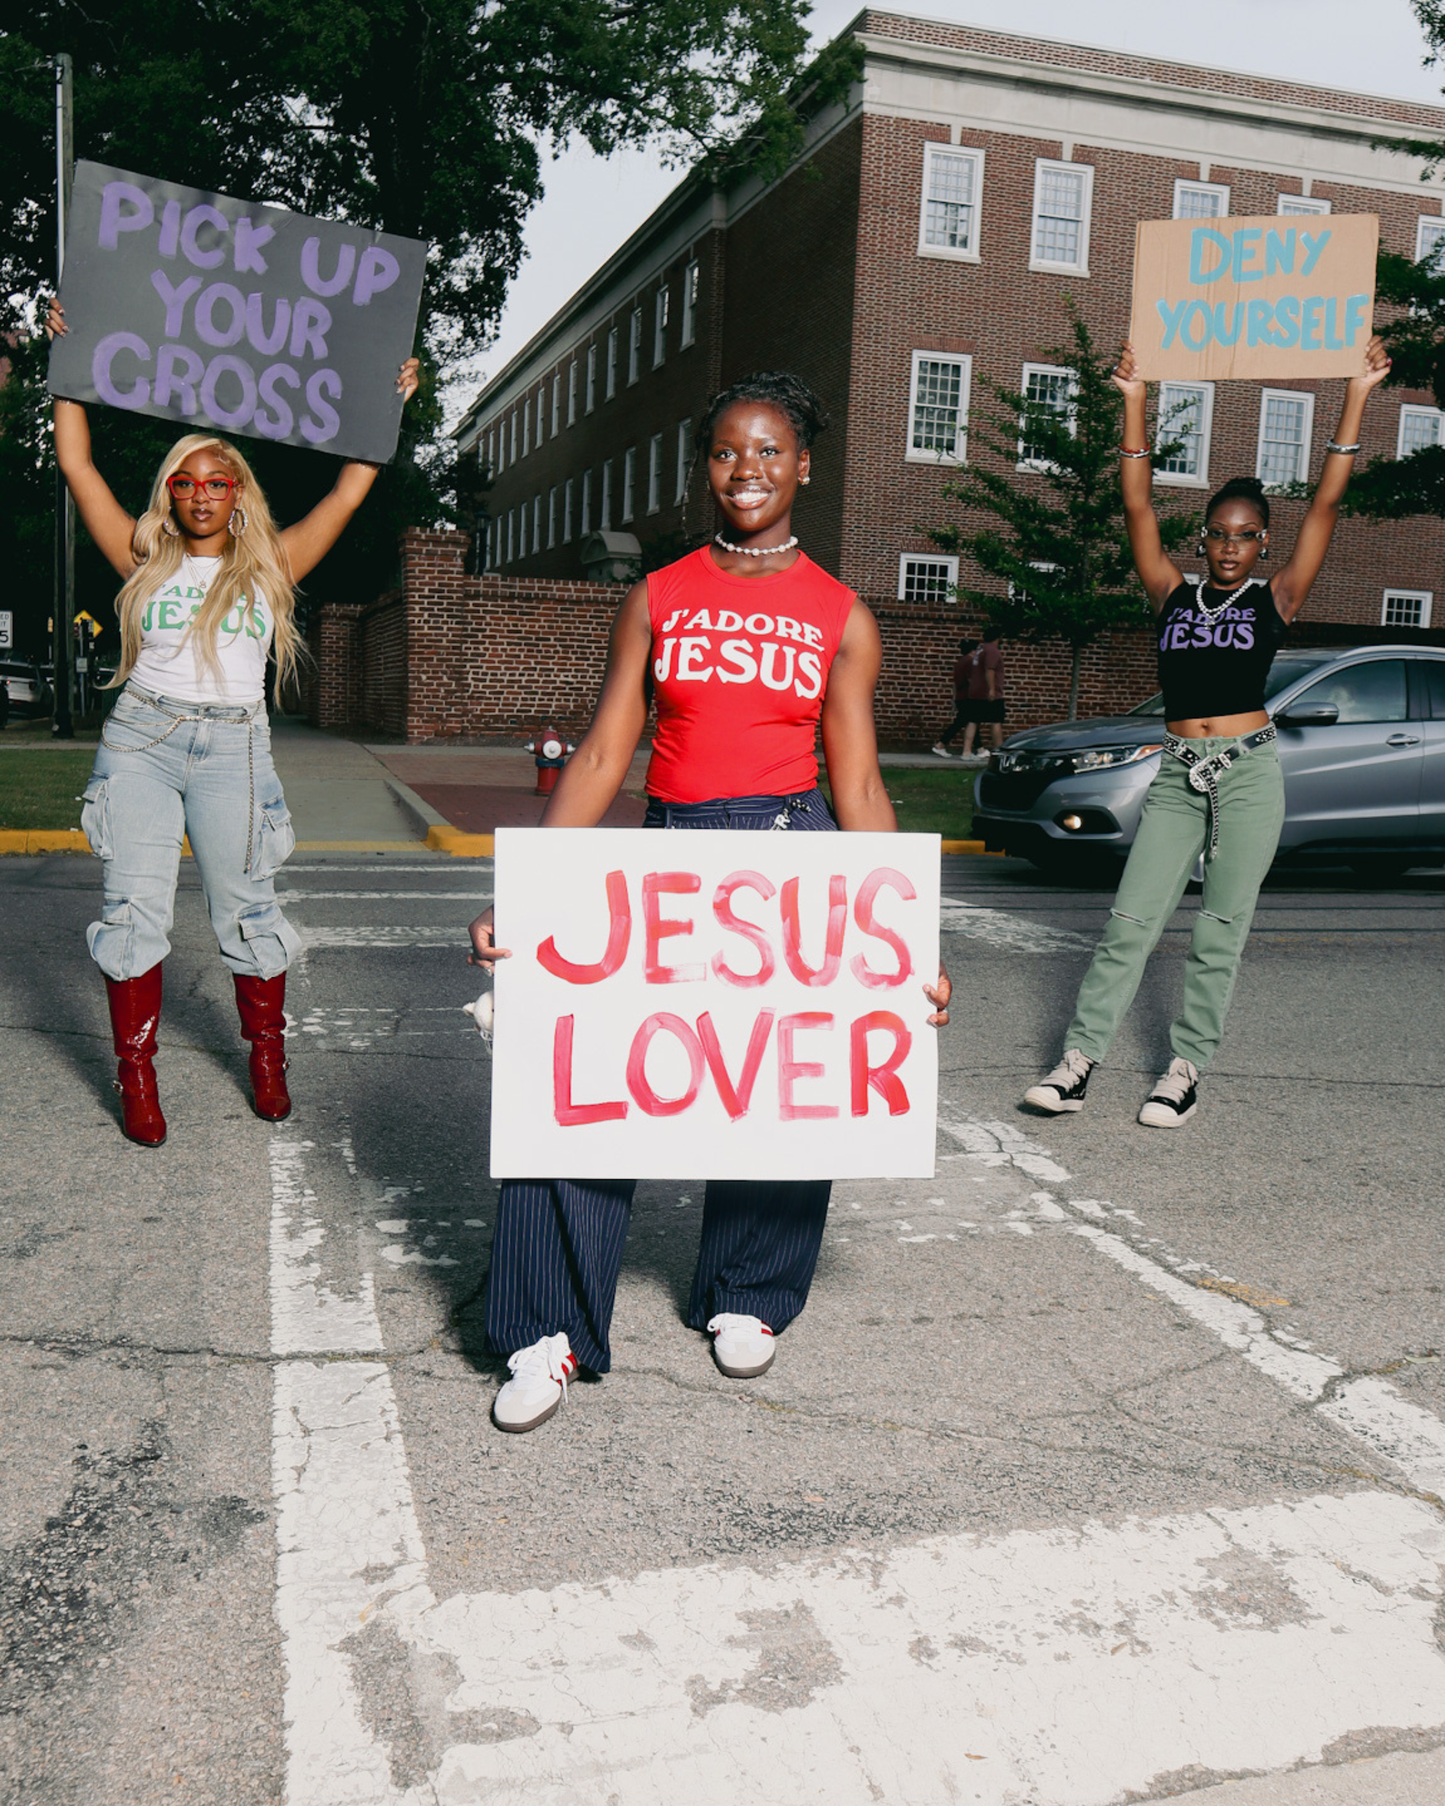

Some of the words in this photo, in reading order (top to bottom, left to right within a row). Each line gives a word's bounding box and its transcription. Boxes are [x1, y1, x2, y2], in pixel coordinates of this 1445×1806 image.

[98, 181, 277, 275] PICK
[301, 236, 400, 306] UP
[1189, 227, 1332, 285] DENY
[150, 269, 333, 360] YOUR
[1156, 294, 1370, 352] YOURSELF
[92, 332, 343, 444] CROSS
[654, 635, 822, 700] JESUS
[662, 608, 825, 652] J'ADORE
[1159, 622, 1255, 652] JESUS
[536, 867, 918, 991] JESUS
[553, 1006, 913, 1127] LOVER
